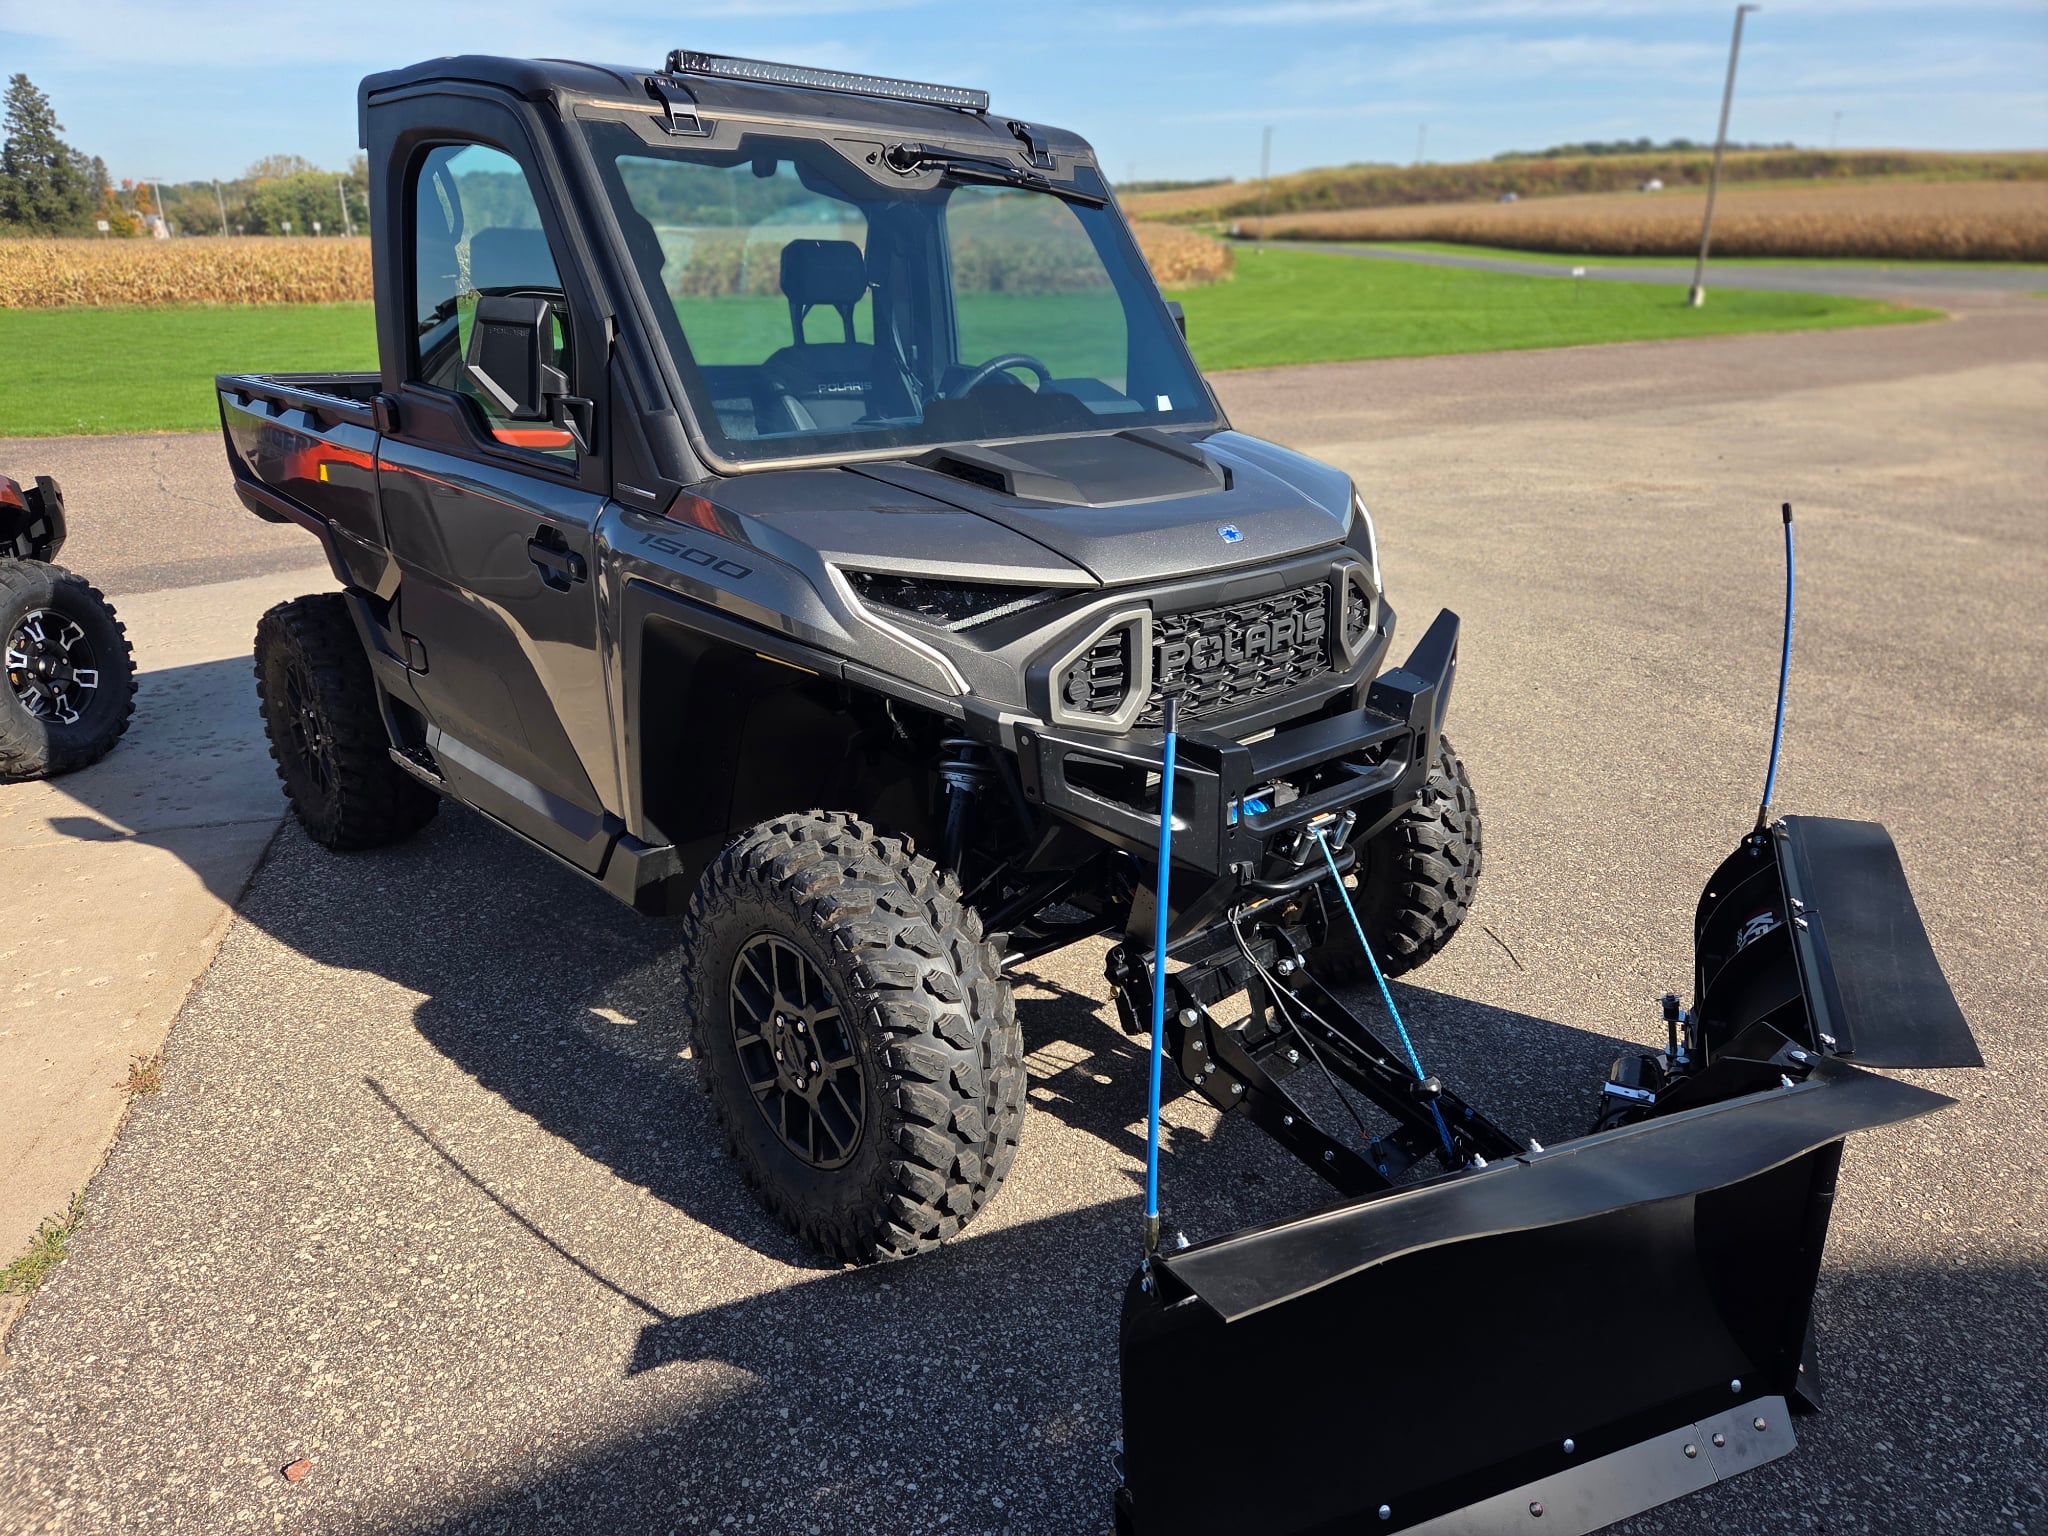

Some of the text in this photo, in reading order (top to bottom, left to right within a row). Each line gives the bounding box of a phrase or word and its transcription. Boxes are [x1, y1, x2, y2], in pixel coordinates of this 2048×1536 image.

[818, 381, 872, 394] POLARIS
[638, 533, 753, 580] 1500
[1160, 606, 1326, 679] POLARIS
